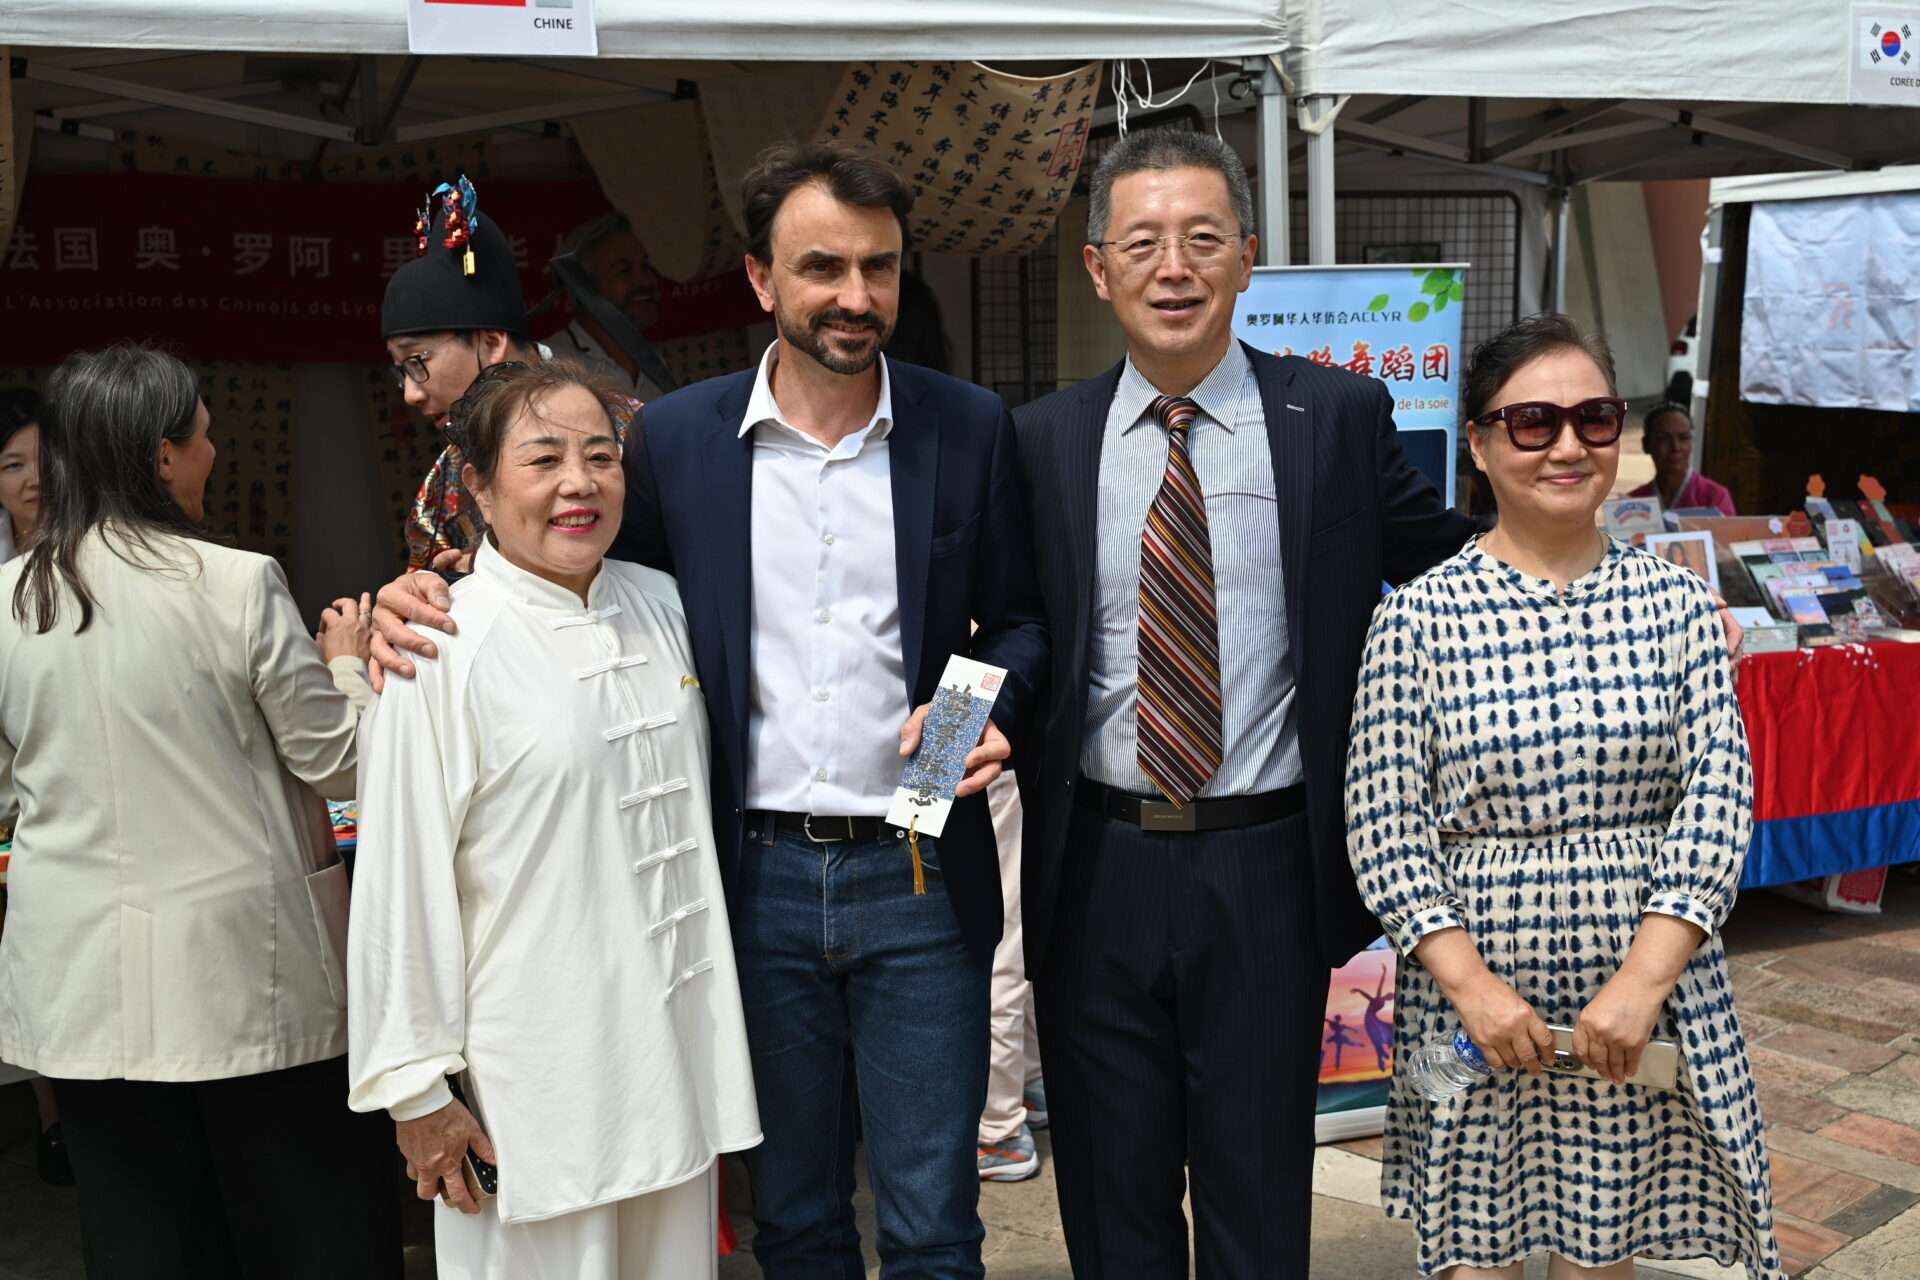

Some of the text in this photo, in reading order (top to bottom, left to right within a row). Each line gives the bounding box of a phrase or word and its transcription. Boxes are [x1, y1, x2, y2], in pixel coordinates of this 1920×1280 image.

[534, 17, 573, 30] CHINE
[5, 225, 99, 272] 法国
[173, 292, 209, 310] des
[217, 295, 299, 315] Chinois
[309, 297, 335, 314] de
[340, 297, 377, 318] Lyo
[1398, 397, 1449, 410] de la soie
